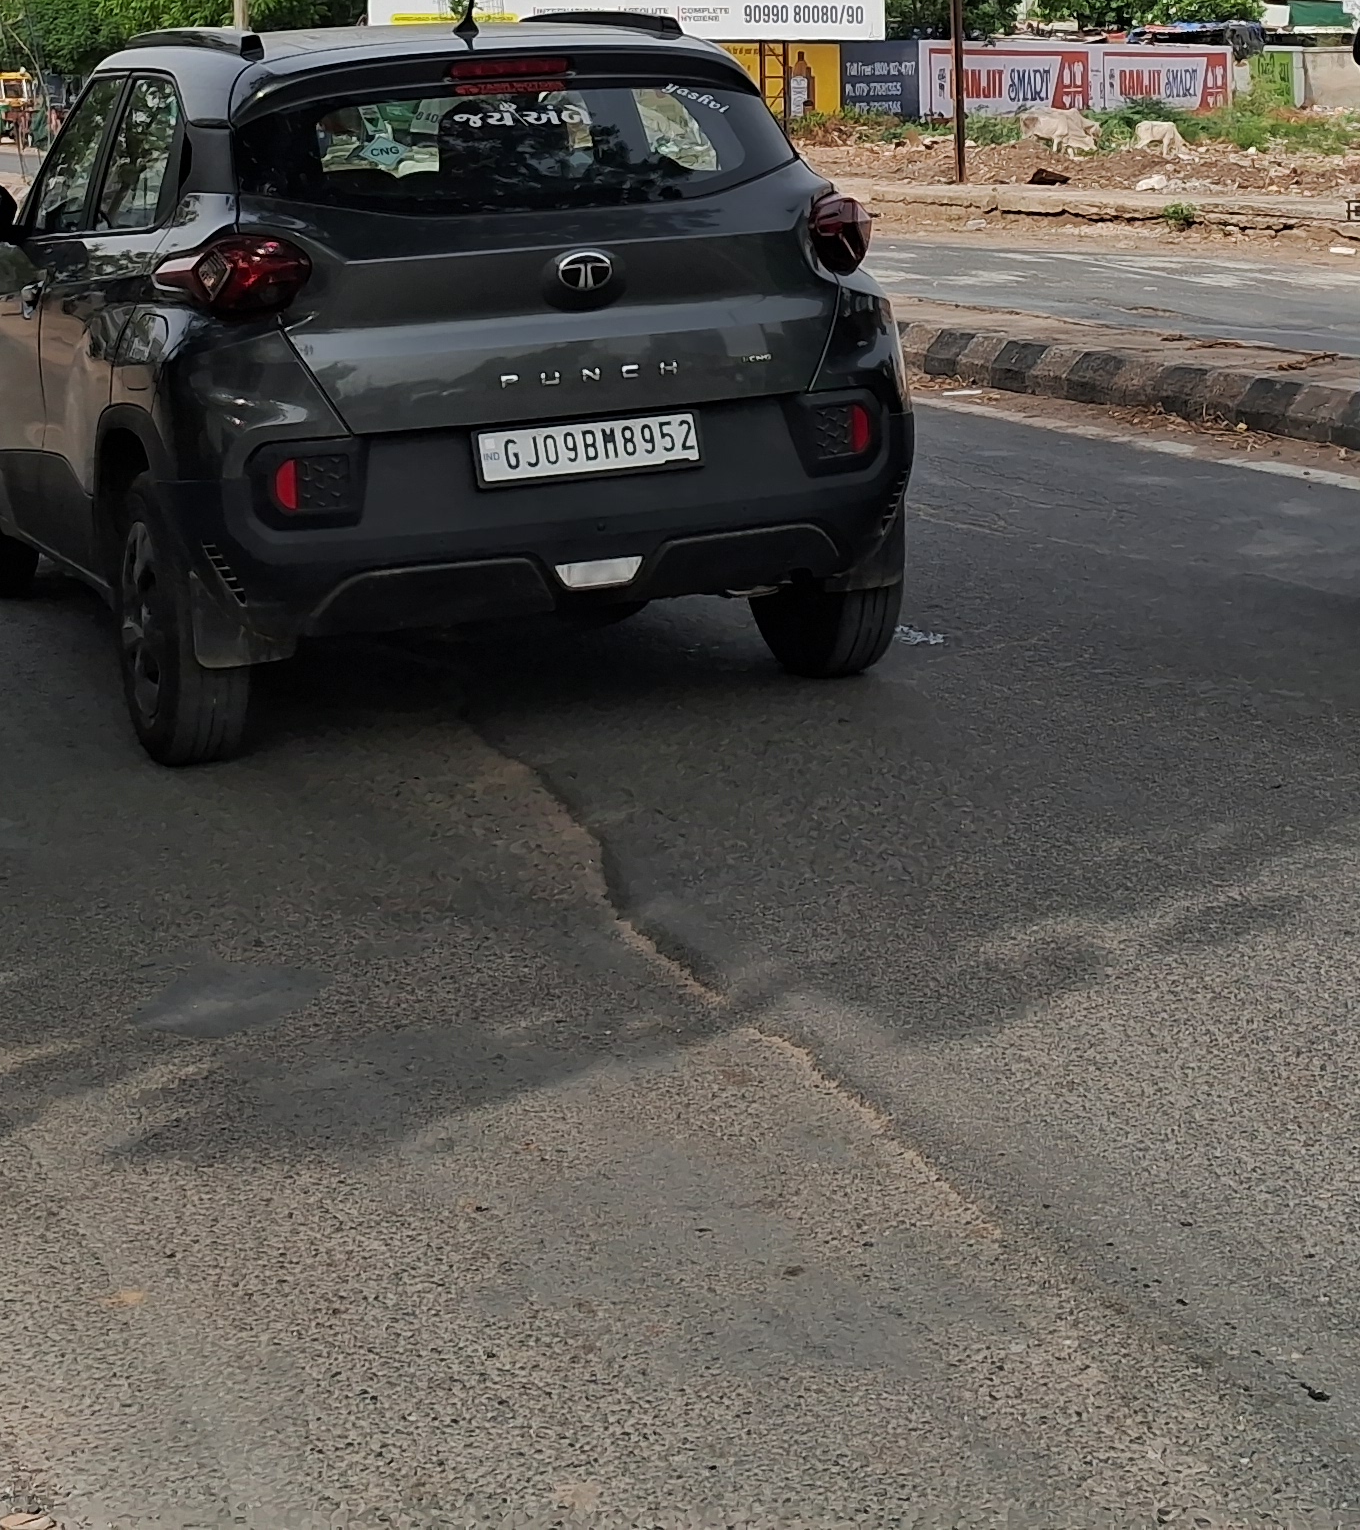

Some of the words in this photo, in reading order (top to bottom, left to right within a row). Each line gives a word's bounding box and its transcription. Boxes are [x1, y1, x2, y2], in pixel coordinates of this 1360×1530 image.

[680, 7, 730, 15] COMPLETE
[743, 4, 789, 25] 90990
[792, 4, 865, 26] 80080/90
[950, 68, 1004, 99] ANJIT
[1007, 67, 1052, 102] SMART
[1164, 67, 1199, 99] SMART
[661, 82, 730, 115] yashvi
[452, 110, 516, 128] જય
[521, 104, 593, 126] અંબે
[370, 145, 400, 157] CNG
[498, 359, 680, 391] PUNCH
[483, 451, 500, 462] IND
[502, 418, 696, 472] GJ09BM8952
